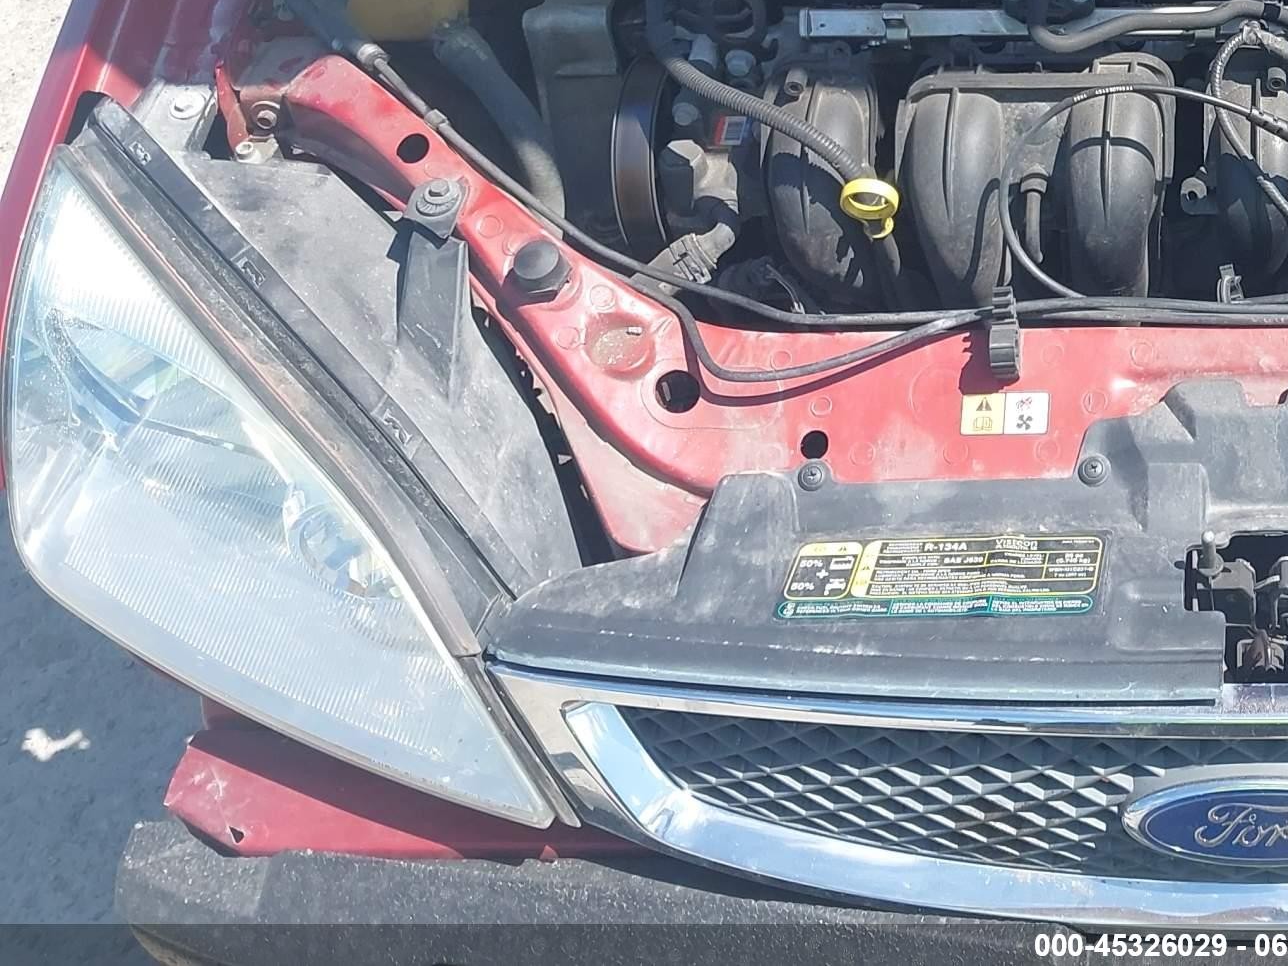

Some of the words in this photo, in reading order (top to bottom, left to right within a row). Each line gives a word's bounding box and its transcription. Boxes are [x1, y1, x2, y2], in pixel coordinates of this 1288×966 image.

[924, 541, 968, 552] R-134A
[800, 559, 824, 568] 50%
[790, 581, 815, 591] 50%
